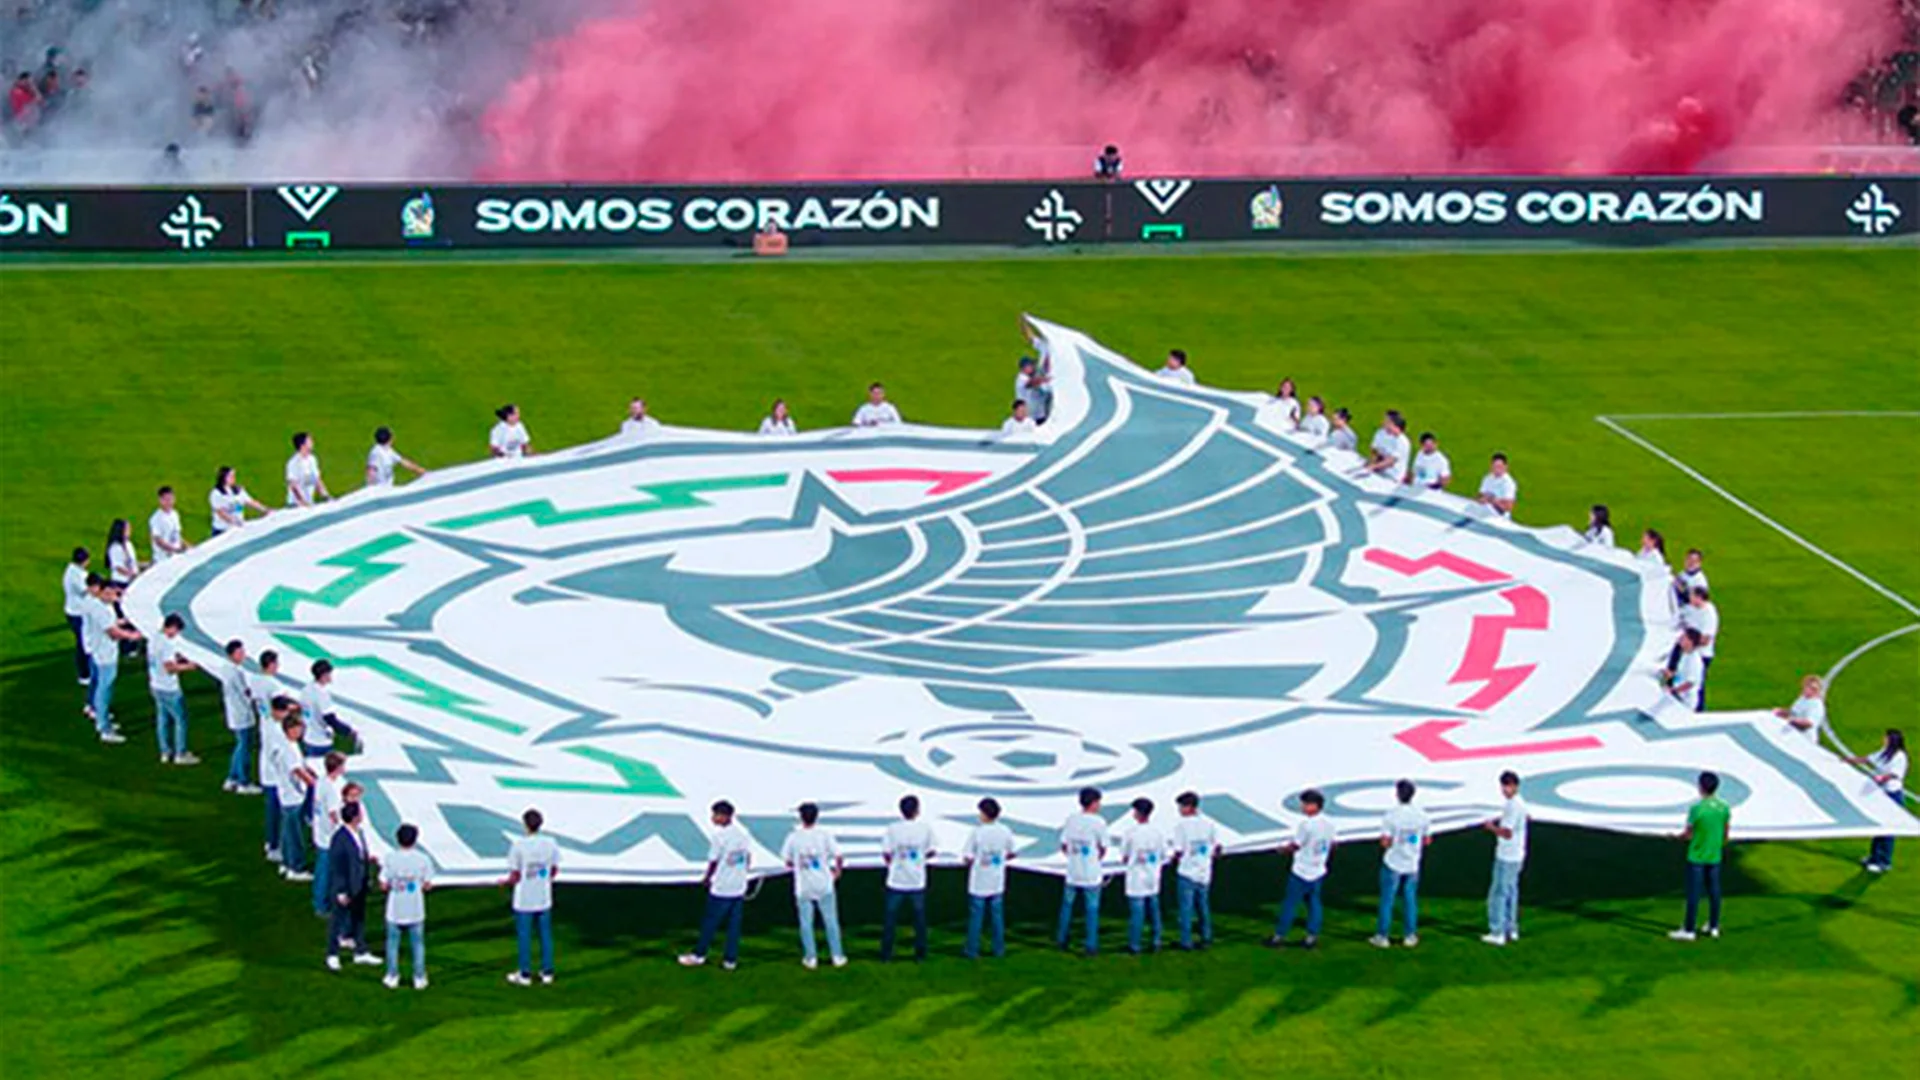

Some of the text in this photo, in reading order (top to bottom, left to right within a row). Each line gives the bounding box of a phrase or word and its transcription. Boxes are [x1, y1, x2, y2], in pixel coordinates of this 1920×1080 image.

[475, 190, 940, 232] SOMOS CORAZÓN
[1320, 184, 1763, 223] SOMOS CORAZÓN
